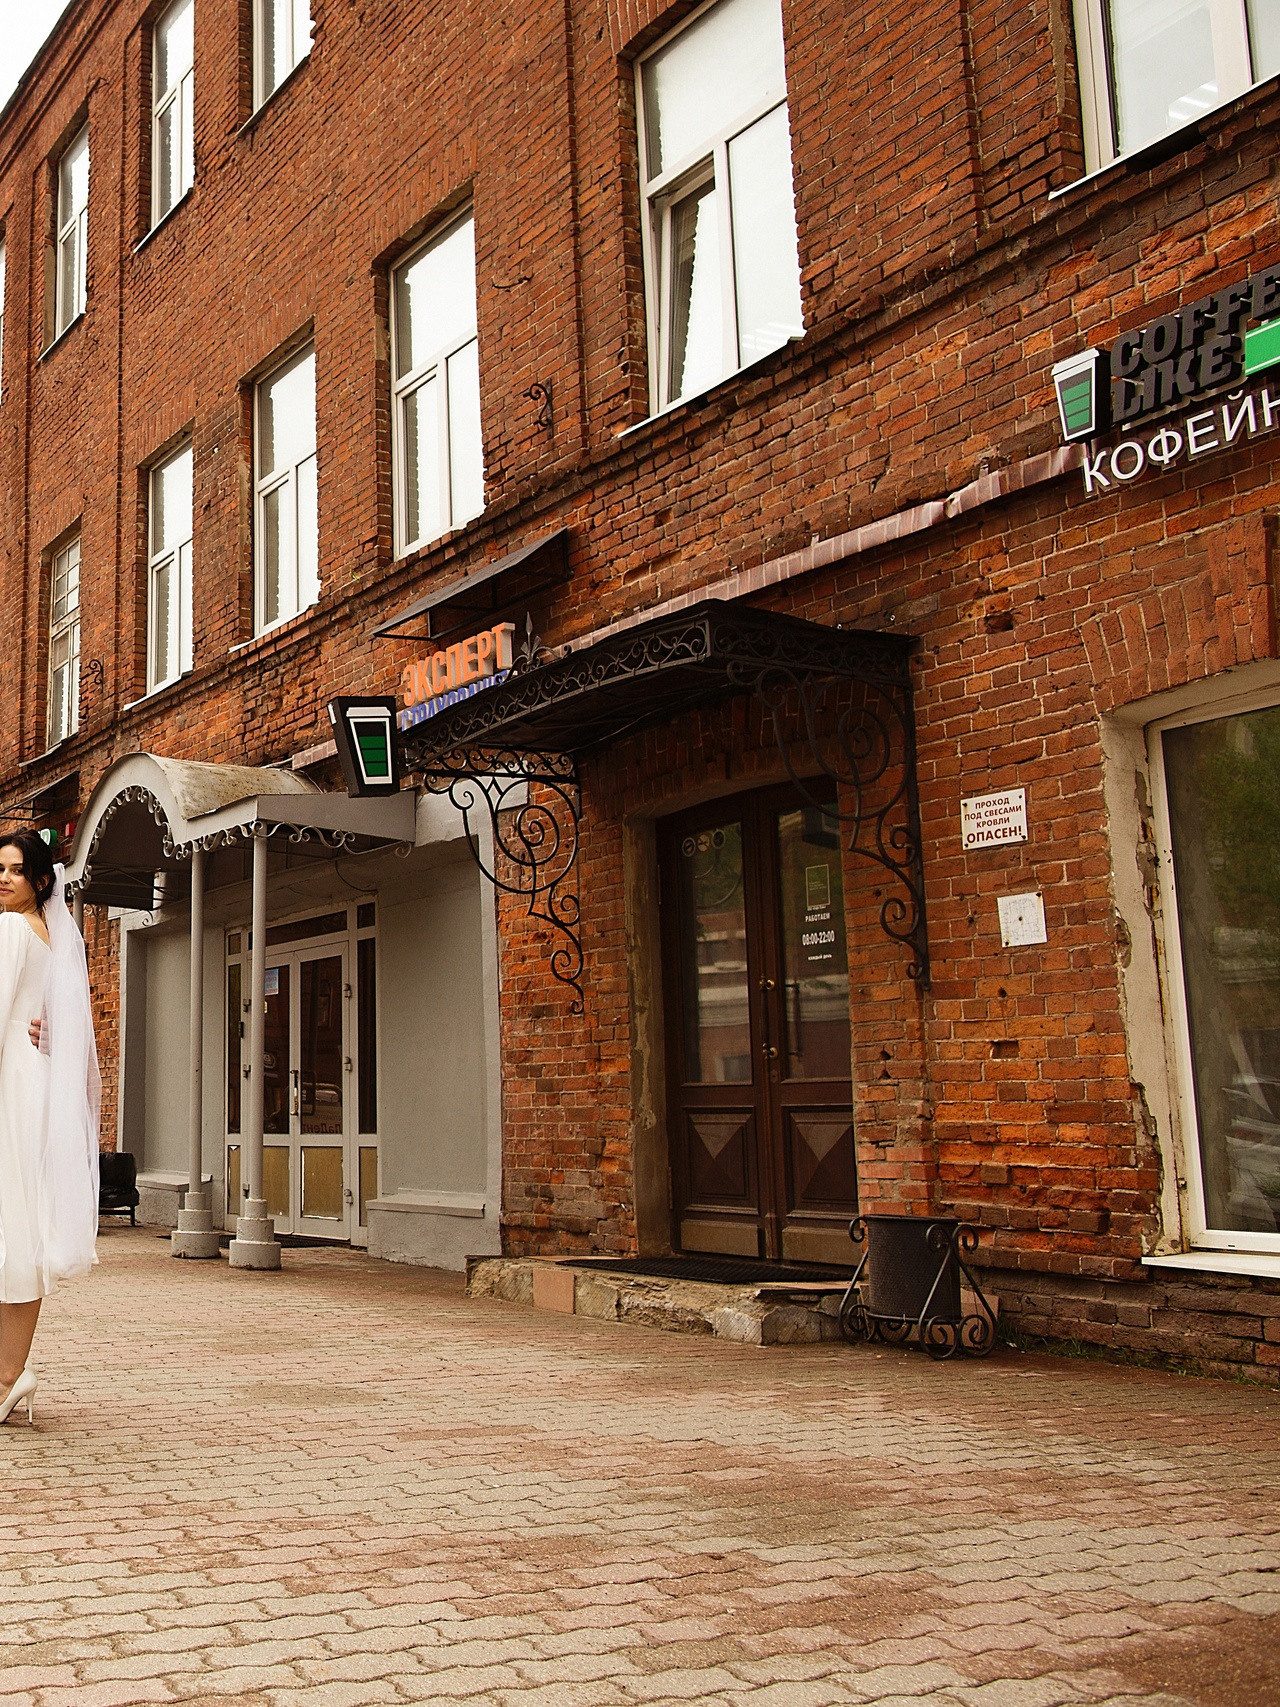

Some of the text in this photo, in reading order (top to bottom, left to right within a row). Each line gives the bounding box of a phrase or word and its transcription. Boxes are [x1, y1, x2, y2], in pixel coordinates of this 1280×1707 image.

[1112, 334, 1234, 424] LIKE
[402, 622, 515, 707] ЭКСПЕРТ
[975, 797, 1010, 810] ПРОХОД
[964, 805, 1022, 822] ПОД СВЕСАМИ
[976, 817, 1010, 828] КРОВЛИ
[966, 825, 1022, 844] ОПАСЕН!
[805, 912, 831, 923] РАБОТАЕМ
